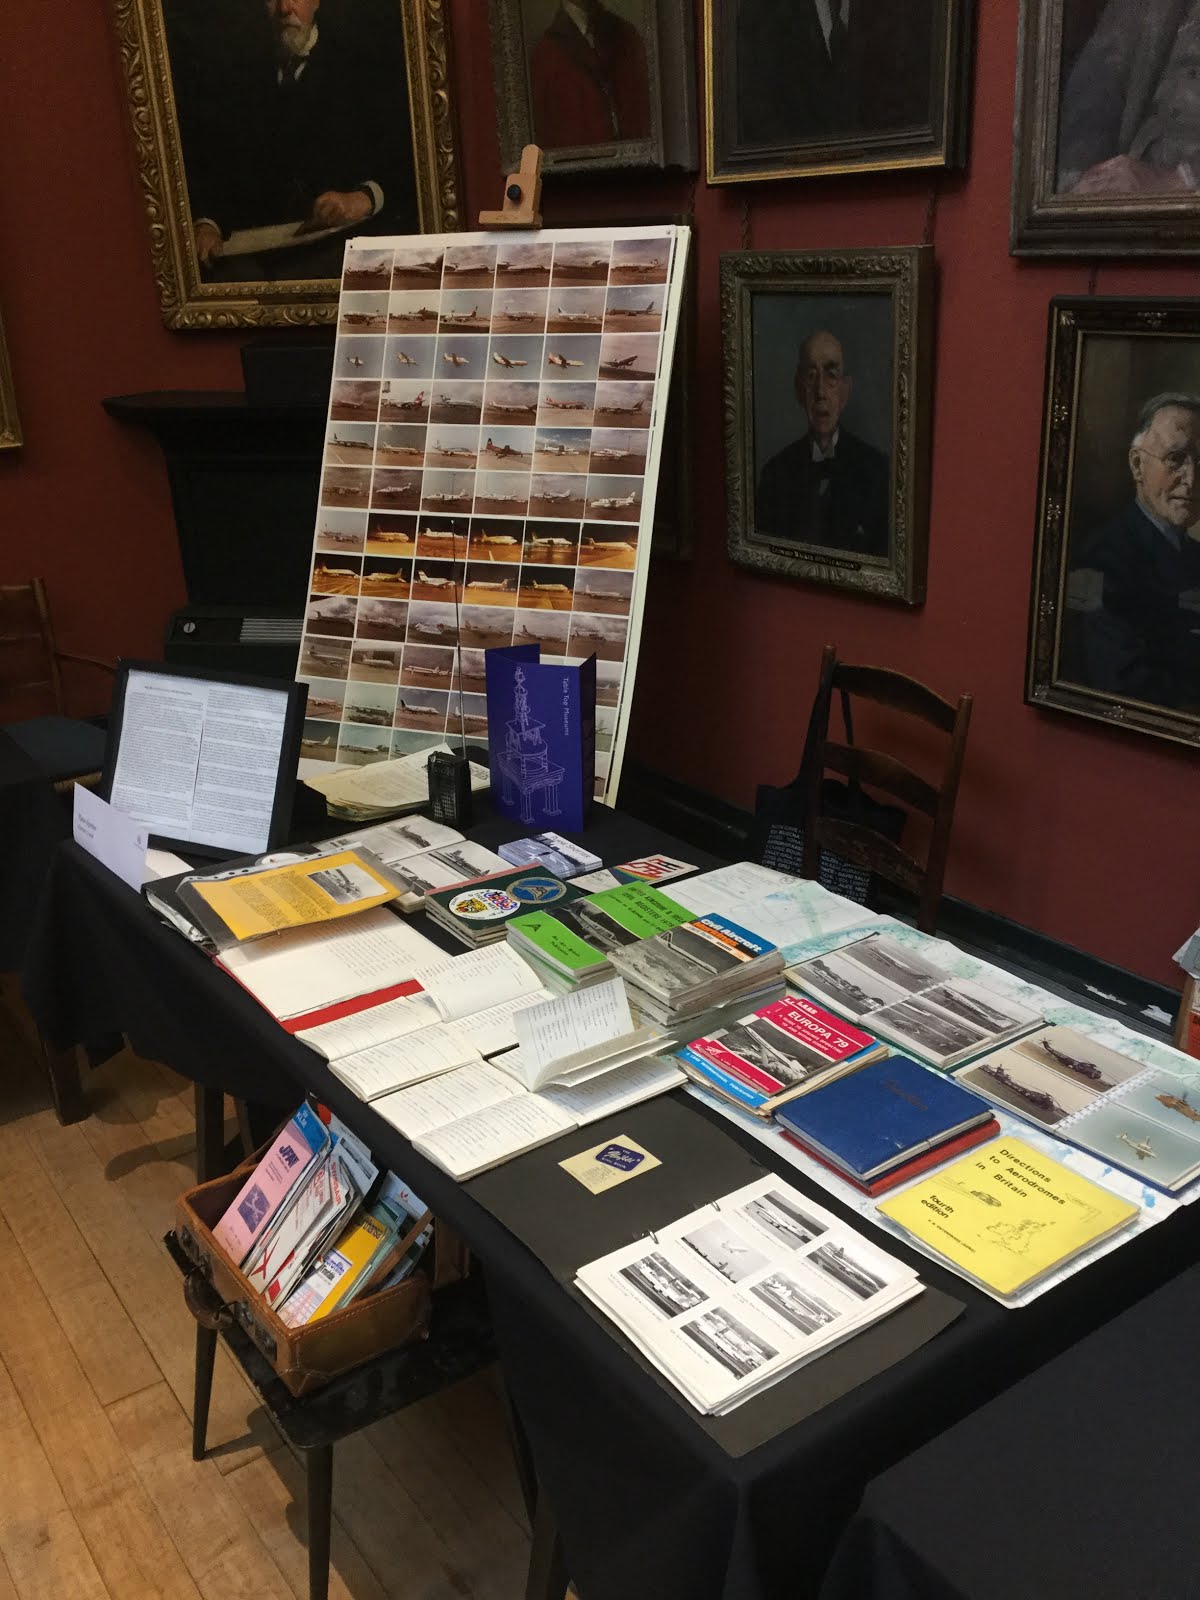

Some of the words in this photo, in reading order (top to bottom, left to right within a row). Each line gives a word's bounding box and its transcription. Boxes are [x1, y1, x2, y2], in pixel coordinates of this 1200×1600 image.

[693, 921, 740, 948] Markings
[701, 918, 724, 933] Civil
[722, 929, 763, 952] Aircraft
[797, 1000, 818, 1015] LAAS
[787, 1025, 799, 1034] AND
[788, 1010, 832, 1039] EUROPA
[833, 1037, 849, 1049] 79
[700, 1060, 728, 1084] INTERNATIONAL
[729, 1082, 755, 1100] PUBLICATION
[295, 1113, 307, 1128] KLM
[975, 1161, 986, 1171] in
[993, 1173, 1028, 1198] Britain
[989, 1155, 1000, 1165] to
[1005, 1167, 1066, 1205] Aerodromes
[1000, 1149, 1051, 1183] Directions
[921, 1199, 949, 1219] edition
[929, 1195, 954, 1214] fourth
